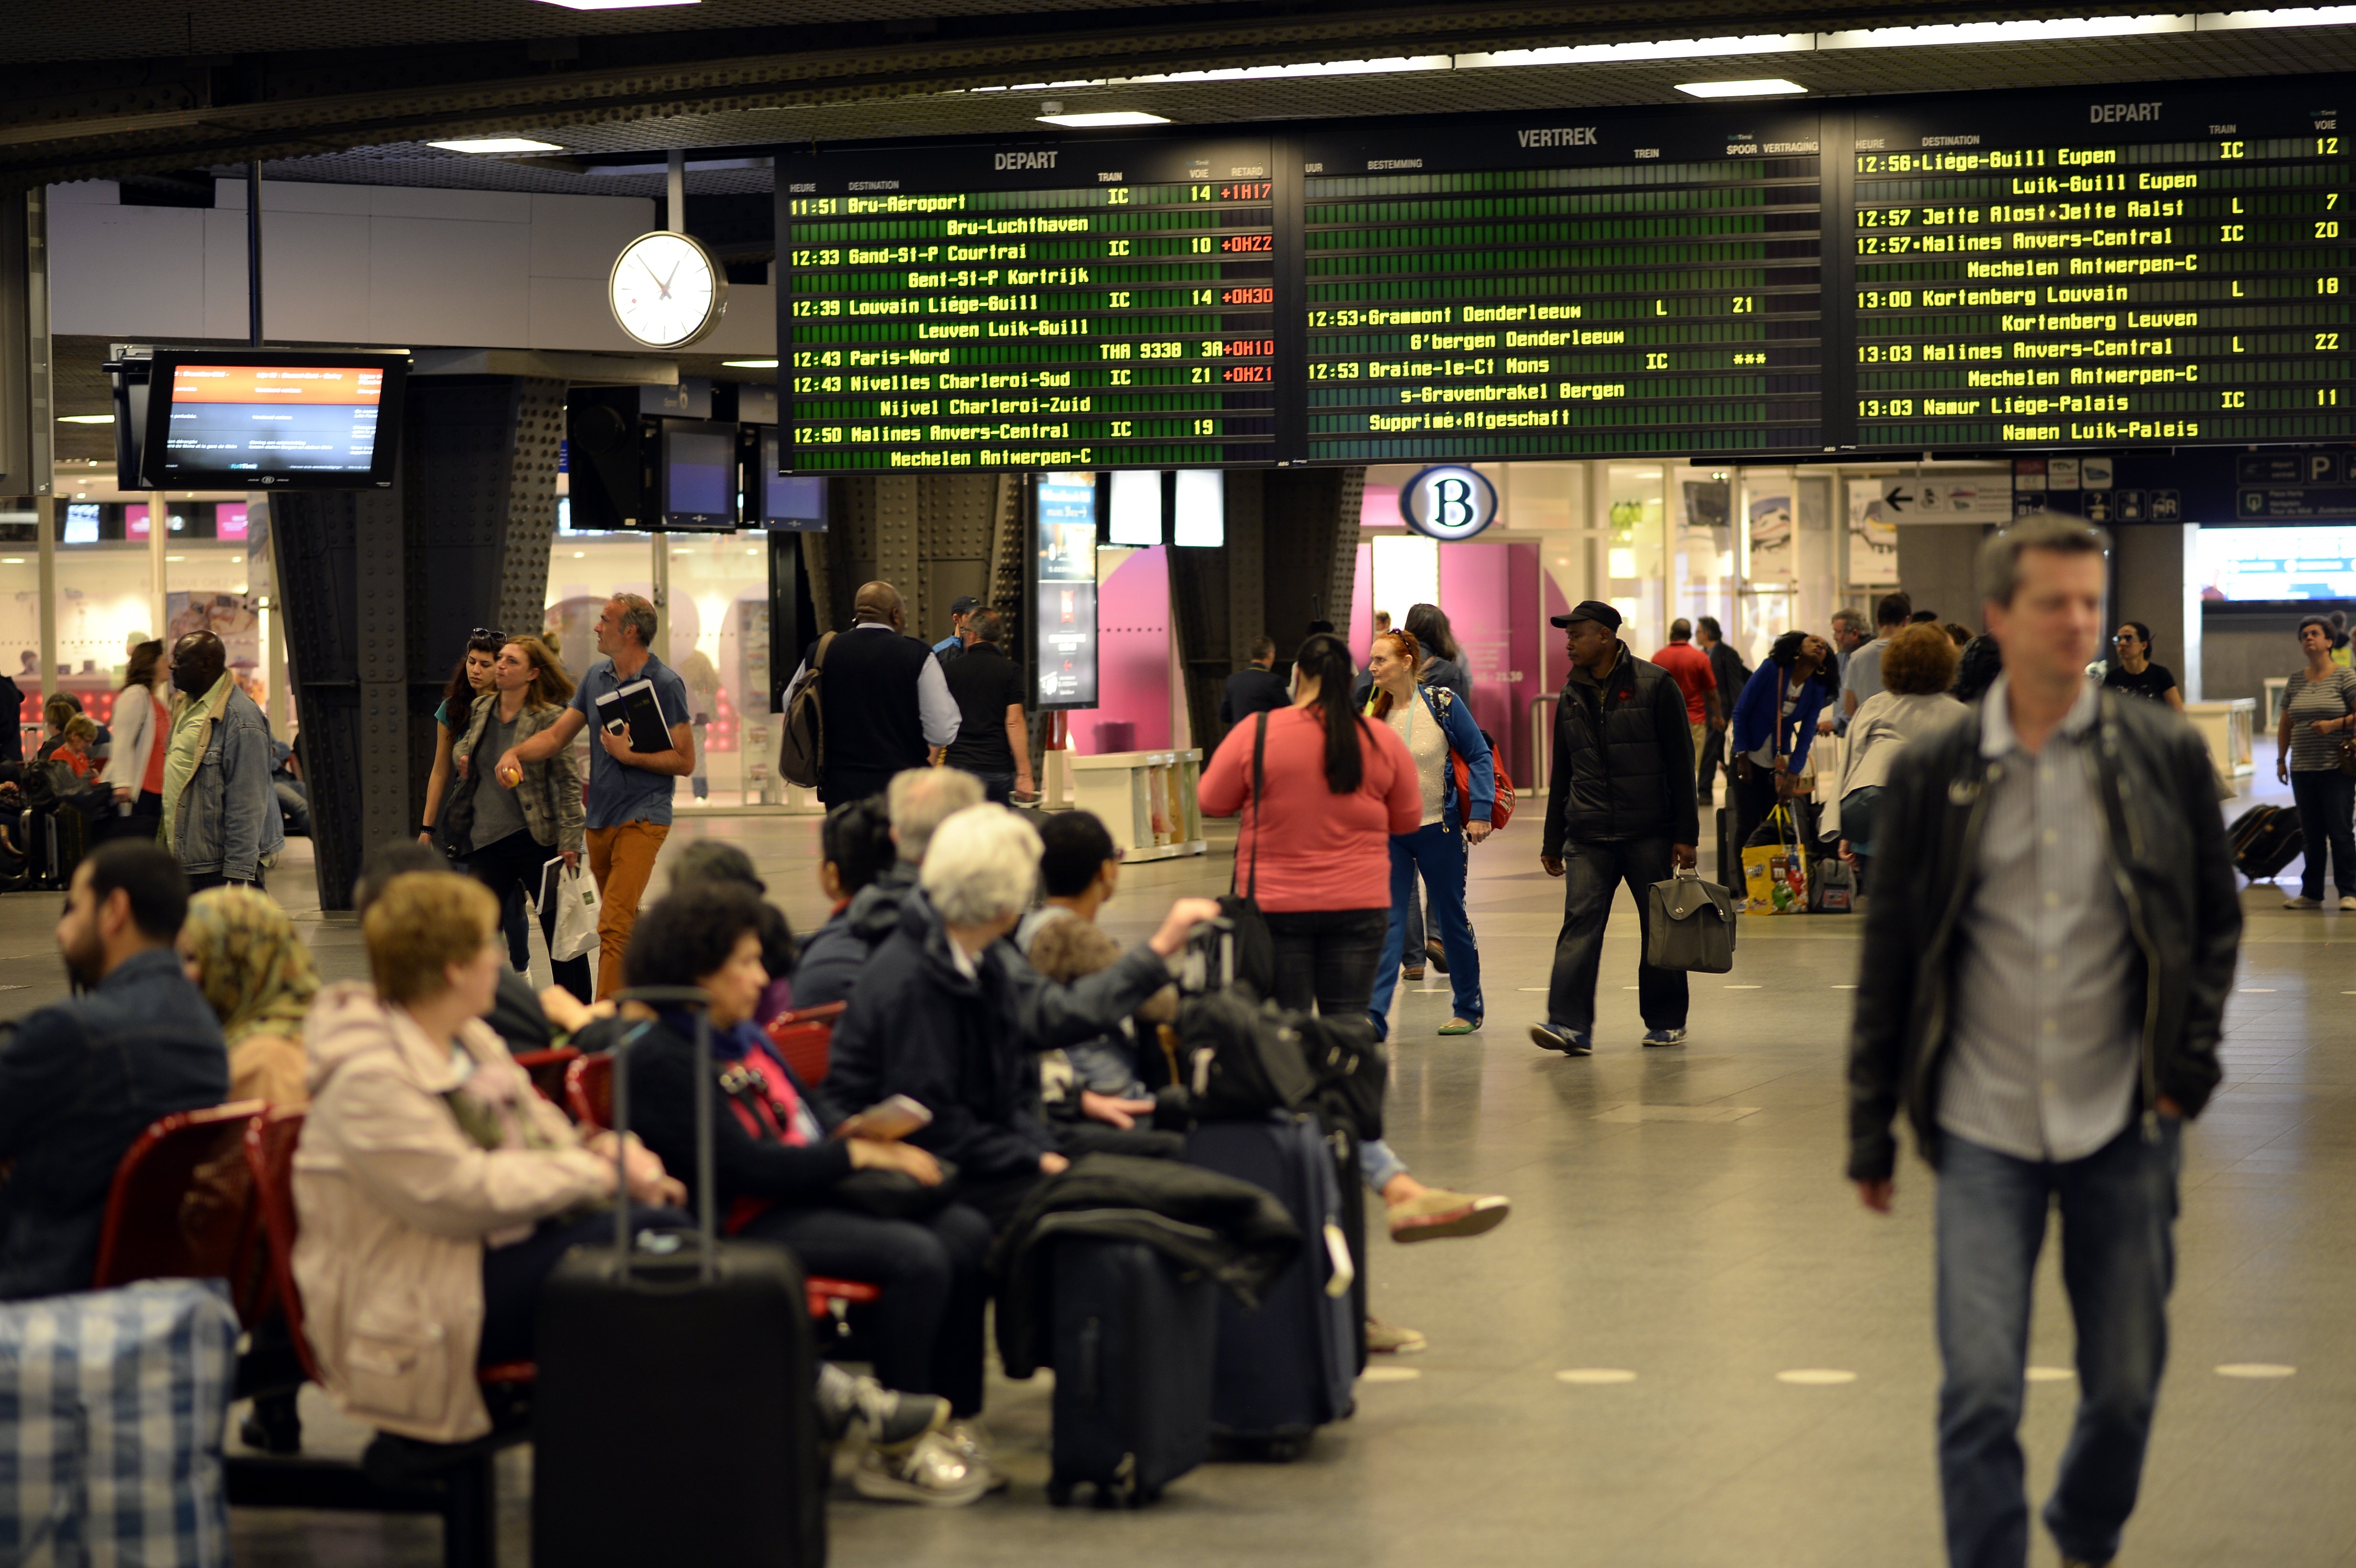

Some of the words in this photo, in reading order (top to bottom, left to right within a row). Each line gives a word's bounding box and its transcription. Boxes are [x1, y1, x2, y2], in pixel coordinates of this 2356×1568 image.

[2090, 102, 2162, 123] DEPART
[1517, 127, 1597, 148] VERTREK
[1855, 139, 1885, 150] HEURE
[1921, 135, 1980, 147] DESTINATION
[2208, 124, 2236, 134] TRAIN
[2314, 120, 2336, 130] VOIE
[995, 151, 1058, 170] DEPART
[1305, 163, 1323, 173] UUR
[1367, 159, 1423, 170] BESTEMMING
[1634, 148, 1659, 159] TREIN
[1726, 144, 1757, 155] SPOOR
[1763, 140, 1819, 154] VERTRAGING
[1857, 155, 1911, 173] 12:56
[2058, 148, 2116, 166] Eupen
[2220, 142, 2244, 158] IC
[2317, 138, 2338, 154] 12
[790, 183, 816, 193] HEURE
[848, 180, 899, 191] DESTINATION
[1097, 172, 1123, 182] TRAIN
[1189, 168, 1209, 178] VOIE
[1231, 166, 1263, 176] RETARD
[2013, 174, 2125, 193] Luik-Guill
[2139, 173, 2197, 191] Eupen
[791, 198, 836, 215] 11:51
[848, 194, 965, 213] Bru-Aéroport
[1108, 188, 1129, 204] IC
[1191, 185, 1210, 201] 14
[1221, 183, 1271, 199] +1H17
[1857, 209, 1911, 227] 12:57
[1922, 207, 1979, 225] Jette
[2127, 199, 2183, 218] Aalst
[2232, 197, 2244, 214] L
[2327, 194, 2338, 210] 7
[947, 217, 1088, 236] Bru-Luchthaven
[1857, 236, 1911, 254] 12:57
[1922, 234, 2002, 252] Malines
[2013, 229, 2171, 249] Anvers-Central
[2221, 225, 2244, 242] IC
[2315, 221, 2338, 238] 20
[792, 250, 840, 266] 12:33
[849, 246, 938, 264] Gand-St-P
[948, 243, 1026, 261] Courtrai
[1109, 240, 1129, 256] IC
[1192, 237, 1211, 253] 10
[1222, 236, 1272, 252] +0H22
[908, 270, 998, 288] Gent-St-P
[1008, 267, 1089, 285] Kortrijk
[1967, 260, 2058, 278] Mechelen
[2070, 254, 2197, 275] Antwerpen-C
[793, 300, 840, 316] 12:39
[850, 298, 919, 315] Louvain
[1109, 292, 1130, 307] IC
[1192, 289, 1211, 305] 14
[1222, 288, 1273, 304] +0H30
[1858, 291, 1911, 308] 13:00
[1923, 288, 2036, 306] Kortenberg
[2047, 284, 2127, 303] Louvain
[2232, 281, 2244, 297] L
[2317, 277, 2338, 294] 18
[1308, 310, 1358, 327] 12:53
[1463, 304, 1581, 321] Denderleeuw
[1656, 300, 1667, 316] L
[1733, 296, 1752, 313] 21
[2002, 313, 2116, 331] Kortenberg
[2128, 311, 2197, 328] Leuven
[919, 323, 979, 338] Leuven
[989, 319, 1088, 337] Luik-Guill
[1506, 329, 1624, 347] Denderleeuw
[794, 351, 841, 367] 12:43
[850, 348, 949, 366] Paris-Nord
[1100, 344, 1131, 359] THA
[1201, 341, 1222, 357] 3A
[1223, 340, 1274, 356] +0H10
[1858, 345, 1912, 362] 13:03
[1923, 344, 2002, 361] Malines
[2014, 338, 2172, 359] Anvers-Central
[2233, 336, 2244, 352] L
[2315, 333, 2338, 350] 22
[1309, 362, 1359, 379] 12:53
[1369, 359, 1494, 378] Braine-le-Ct
[1506, 358, 1549, 373] Mons
[1646, 353, 1668, 370] IC
[1968, 369, 2059, 387] Mechelen
[2071, 365, 2197, 385] Antwerpen-C
[794, 377, 841, 392] 12:43
[851, 375, 930, 391] Nivelles
[939, 371, 1070, 389] Charleroi-Sud
[1110, 370, 1131, 385] IC
[1192, 367, 1210, 383] 21
[1223, 366, 1271, 382] +0H21
[1401, 383, 1547, 403] s-Gravenbrakel
[1560, 382, 1625, 400] Bergen
[1859, 399, 1912, 416] 13:03
[1924, 399, 1980, 415] Namur
[2221, 392, 2245, 408] IC
[2318, 389, 2335, 405] 11
[881, 400, 938, 418] Nijvel
[950, 396, 1091, 414] Charleroi-Zuid
[795, 427, 842, 443] 12:50
[851, 426, 921, 442] Malines
[930, 423, 1069, 440] Anvers-Central
[1111, 421, 1132, 436] IC
[1194, 419, 1213, 435] 19
[2003, 424, 2060, 440] Namen
[2072, 421, 2198, 439] Luik-Paleis
[891, 451, 971, 467] Mechelen
[981, 448, 1091, 466] Antwerpen-C
[2312, 457, 2330, 480] P
[1435, 479, 1473, 527] B
[173, 516, 183, 530] 2
